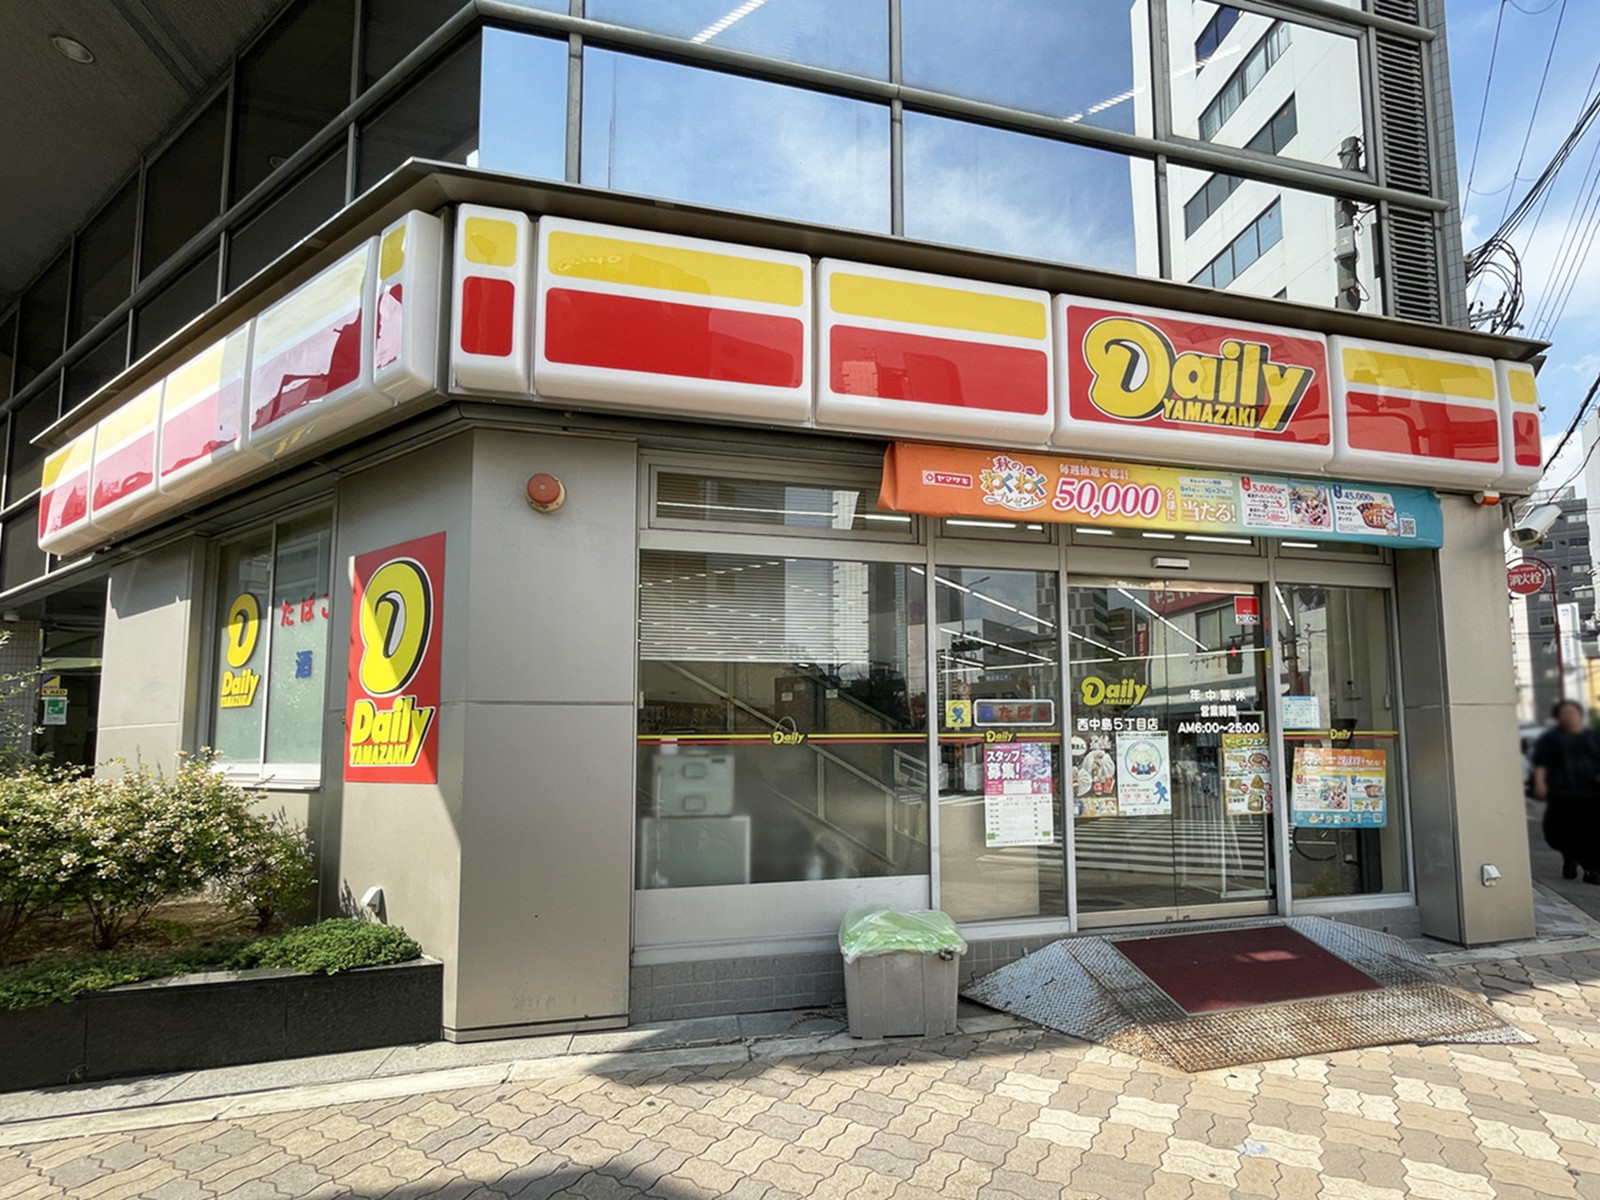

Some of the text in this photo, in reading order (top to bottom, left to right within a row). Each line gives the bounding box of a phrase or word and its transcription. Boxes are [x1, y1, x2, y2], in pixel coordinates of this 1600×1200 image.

[1083, 317, 1315, 430] Daily
[1163, 398, 1256, 427] YAMAZAKI
[995, 458, 1021, 471] 秋の
[981, 471, 1046, 496] わくわく
[998, 492, 1038, 506] プレゼント
[1053, 479, 1160, 518] 50,000
[1182, 500, 1236, 522] 当たる!
[1509, 572, 1542, 586] 消火栓
[221, 668, 260, 707] Daily
[1081, 676, 1148, 706] Daily
[1190, 689, 1246, 701] 年中無休
[1200, 705, 1237, 717] 営業時間
[351, 697, 436, 765] Daily
[1077, 717, 1159, 732] 西中島5丁目店
[1178, 722, 1260, 734] AM6:00~25:00
[773, 731, 805, 745] Daily
[351, 744, 408, 764] YAMAZAKI
[987, 751, 1020, 762] スタッフ
[987, 762, 1020, 780] 募集!
